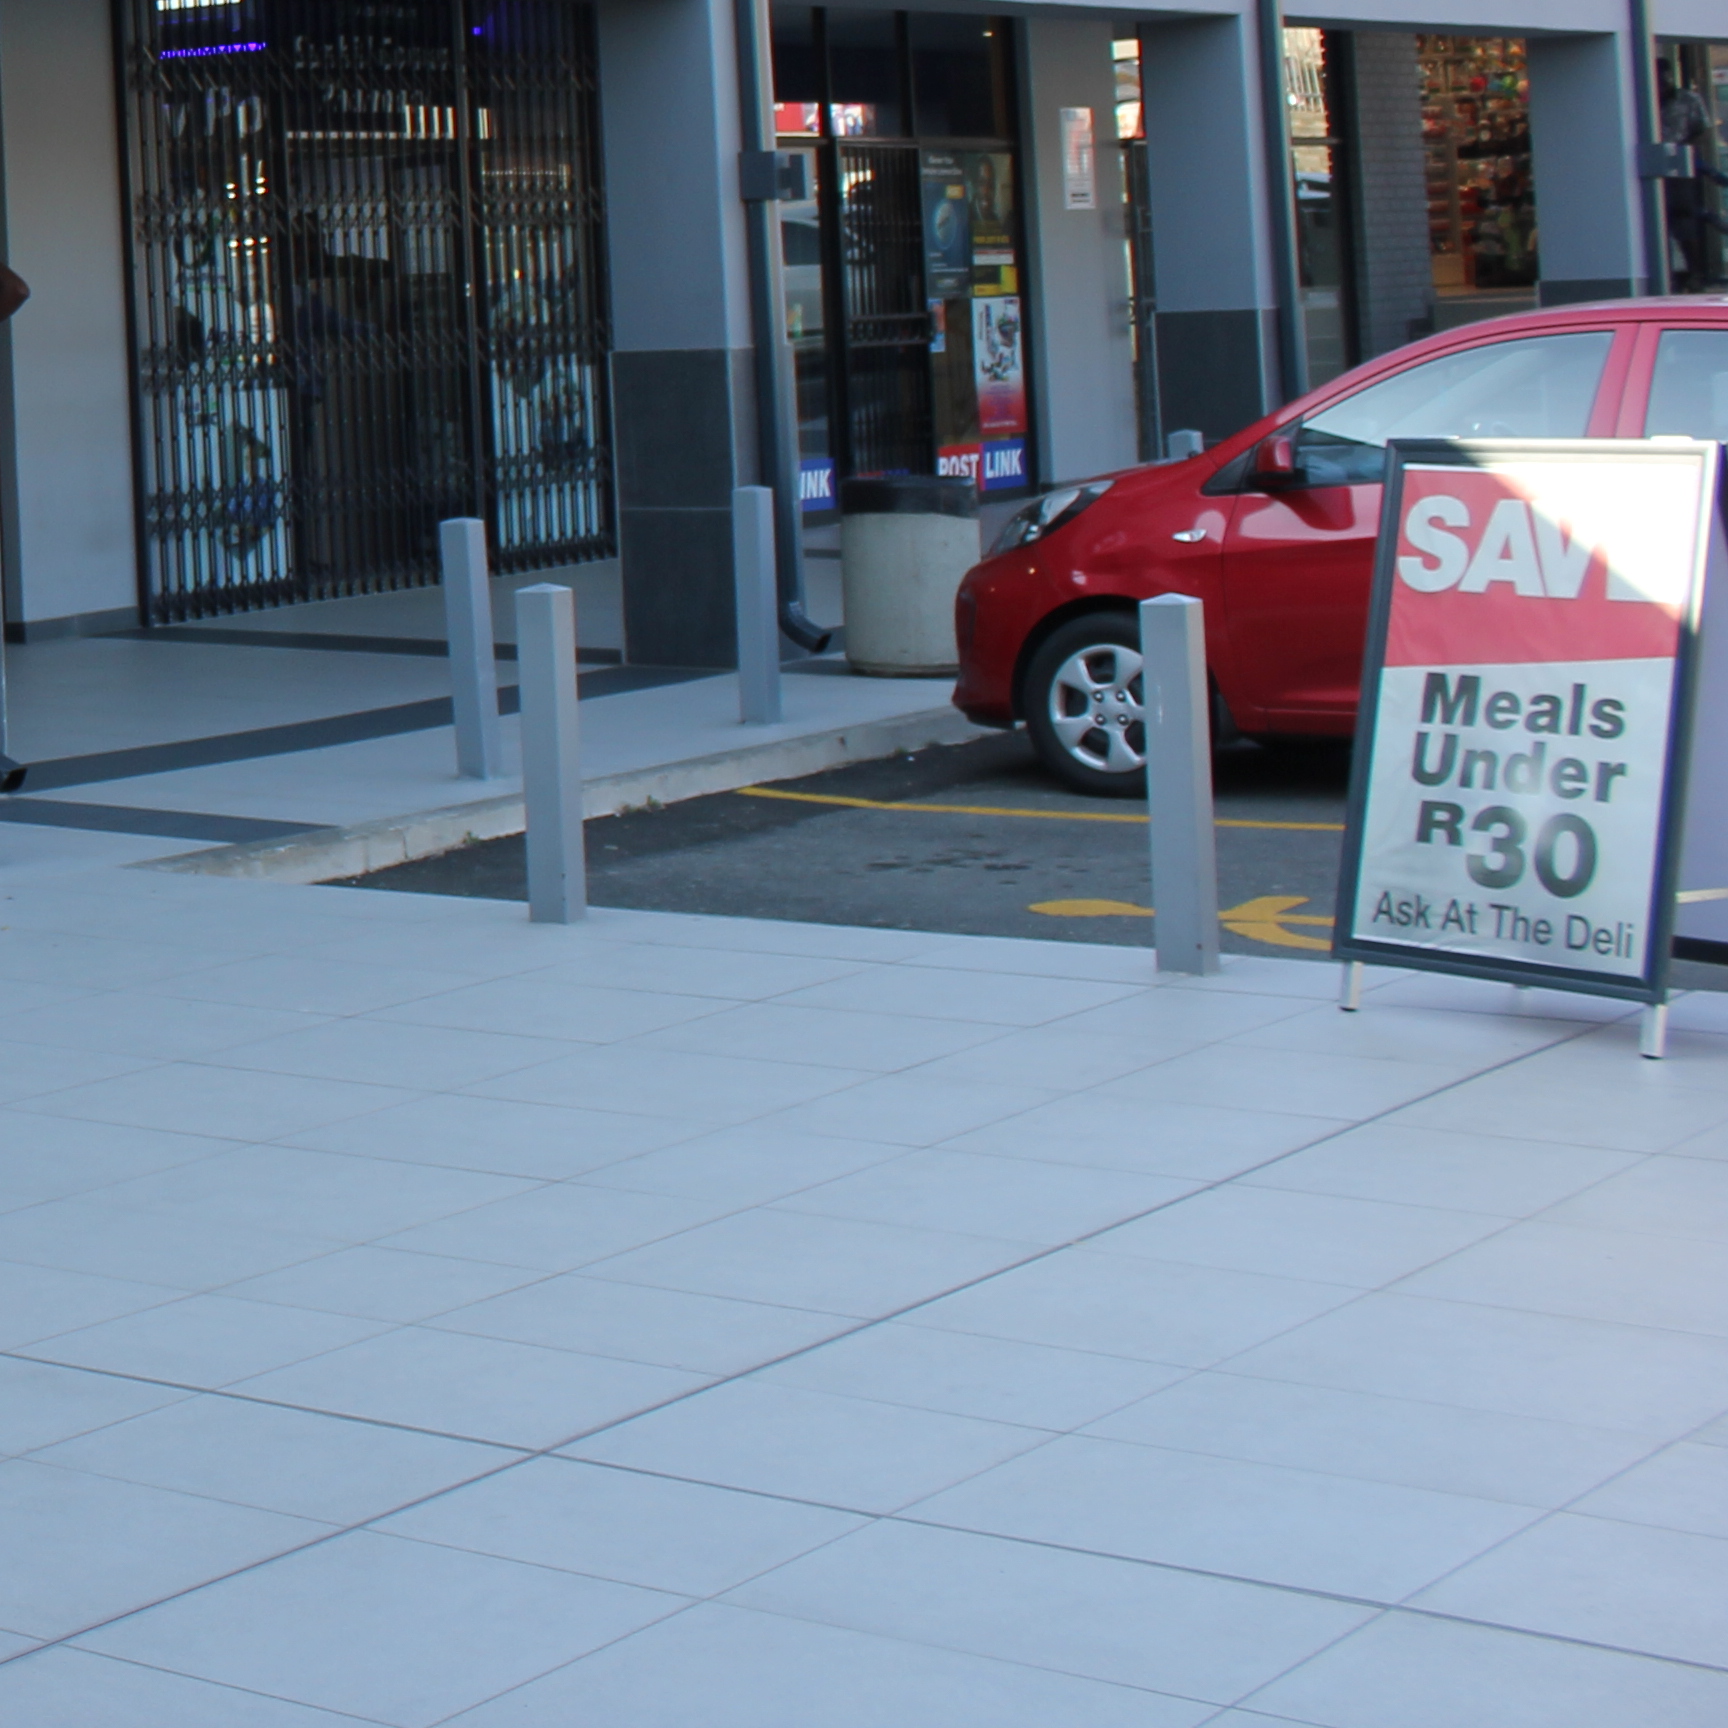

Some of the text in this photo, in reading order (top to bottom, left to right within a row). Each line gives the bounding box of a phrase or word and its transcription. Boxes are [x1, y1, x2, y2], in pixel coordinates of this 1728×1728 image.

[799, 468, 832, 500] INK
[985, 447, 1023, 479] LINK
[1419, 671, 1626, 739] Meals
[1411, 731, 1627, 804] Under
[1416, 800, 1598, 899] R30
[1372, 890, 1635, 960] Ask At The Deli
